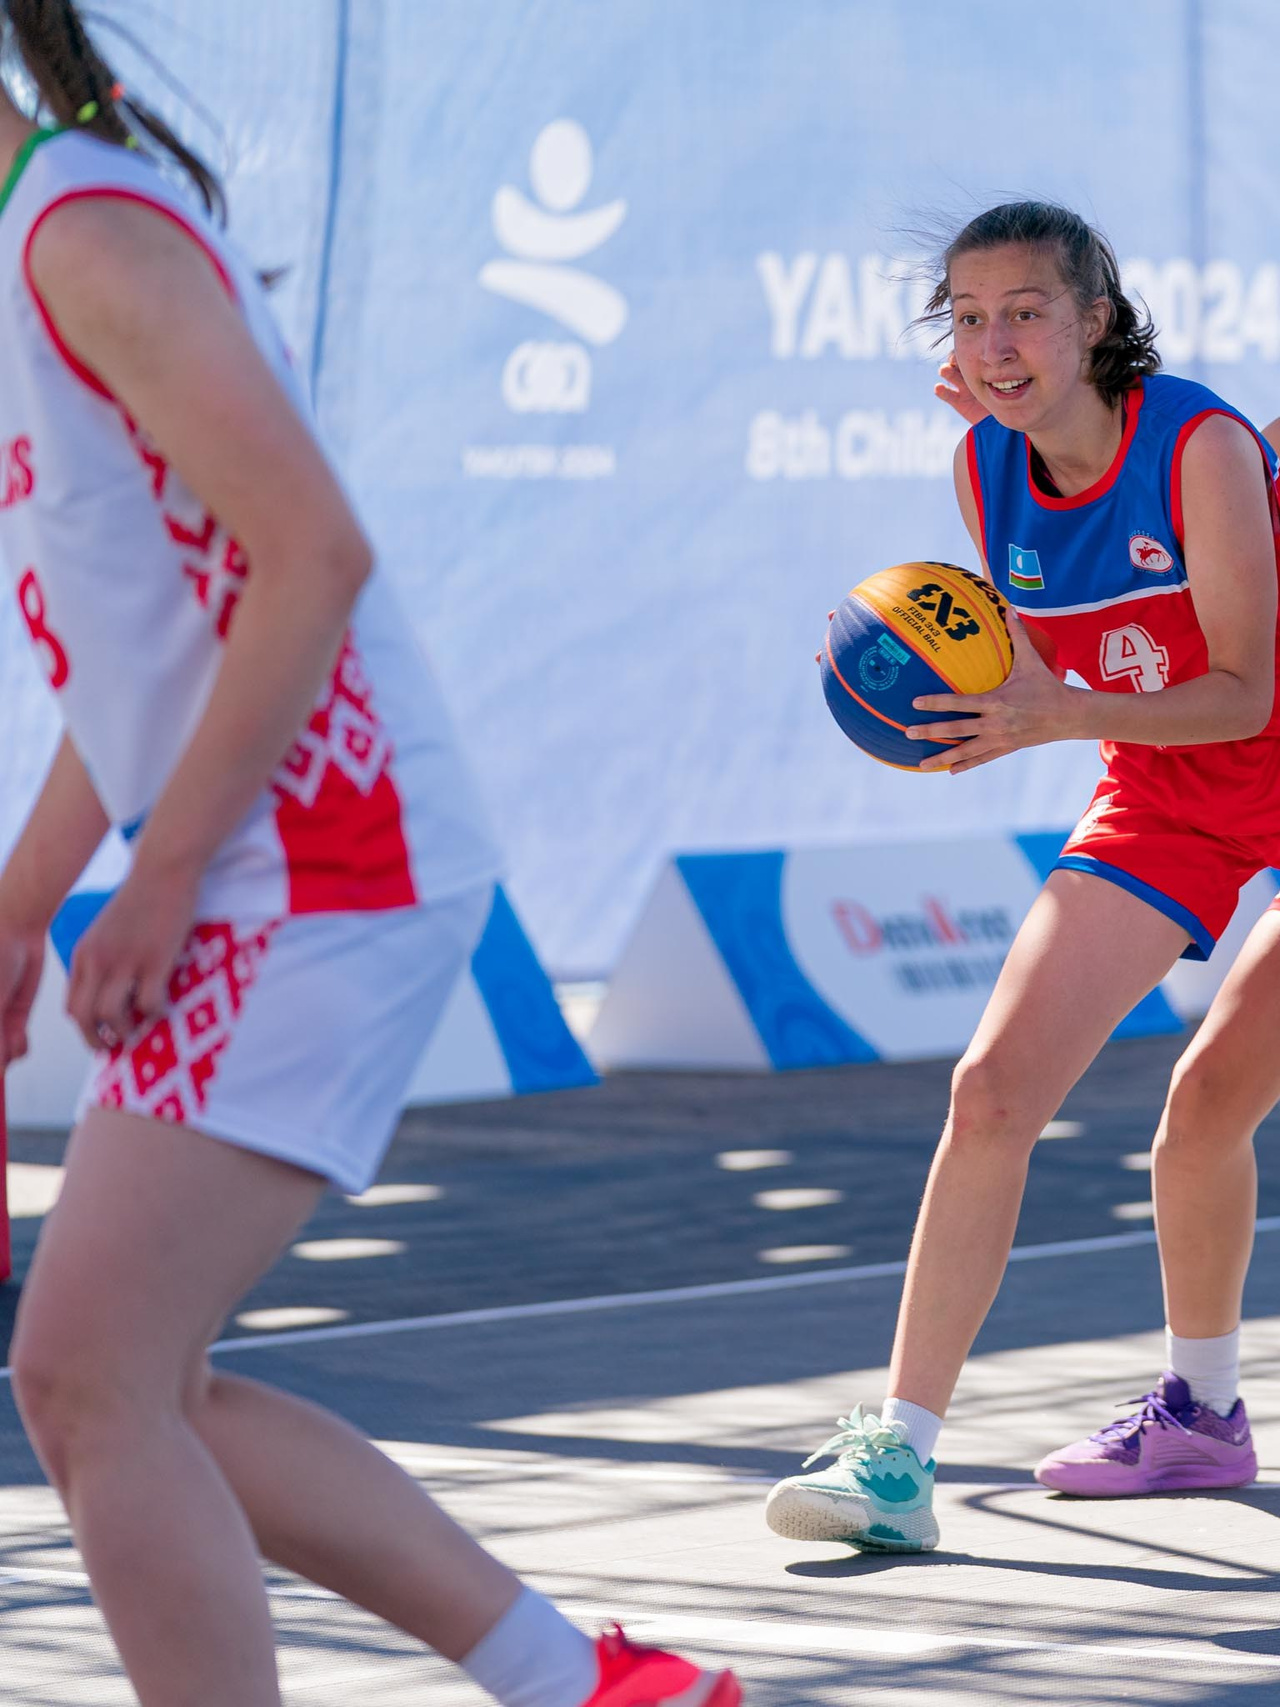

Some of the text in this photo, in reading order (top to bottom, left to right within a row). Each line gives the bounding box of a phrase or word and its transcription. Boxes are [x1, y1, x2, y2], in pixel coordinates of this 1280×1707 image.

[892, 606, 924, 634] OFFICIAL
[923, 633, 941, 653] BALL
[907, 606, 926, 623] FIBA
[1099, 622, 1170, 693] 4
